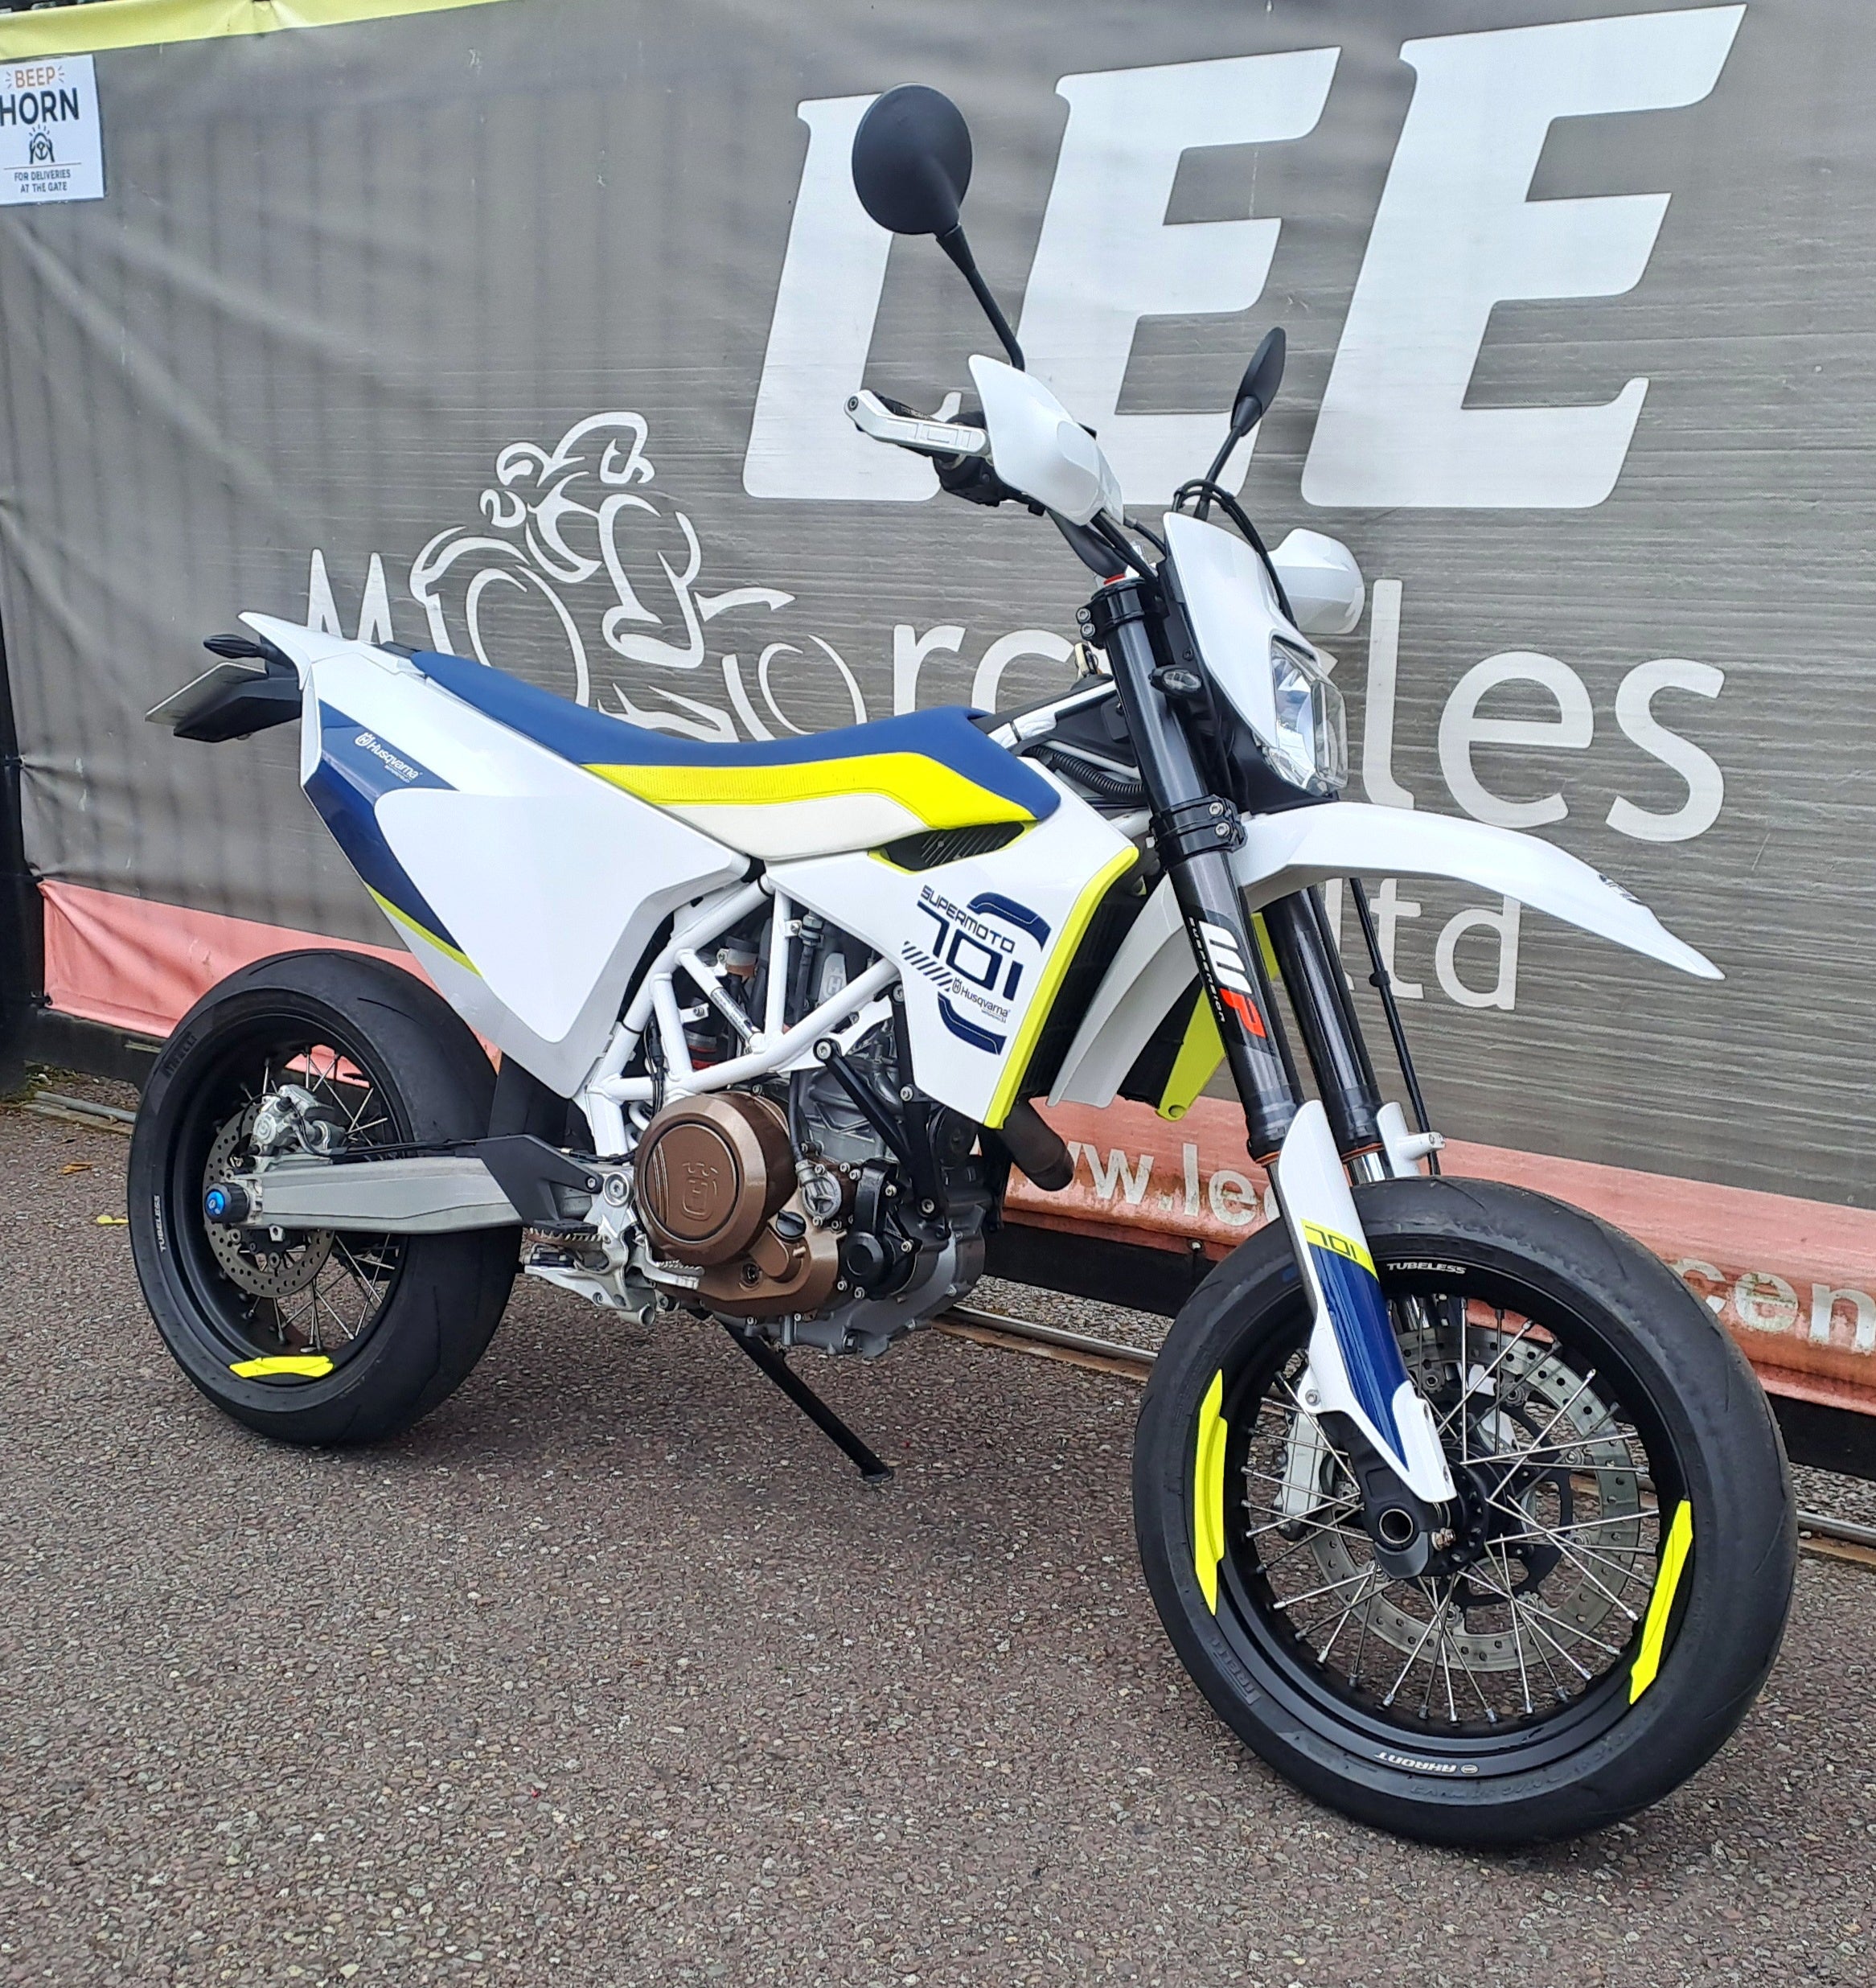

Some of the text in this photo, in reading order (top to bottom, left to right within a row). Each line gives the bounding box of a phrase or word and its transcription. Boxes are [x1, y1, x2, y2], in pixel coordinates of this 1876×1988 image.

[14, 66, 55, 88] BEEP
[0, 87, 80, 127] HORN
[14, 169, 71, 182] FOR DELIVERIES
[20, 181, 68, 193] AT THE GATE
[743, 4, 1747, 508] LEE
[366, 741, 419, 779] Husqvarna
[920, 884, 1016, 954] SUPERMOTO
[917, 899, 1024, 1001] 701
[959, 985, 1009, 1018] Husqvarna
[1386, 1262, 1467, 1275] TUBELESS
